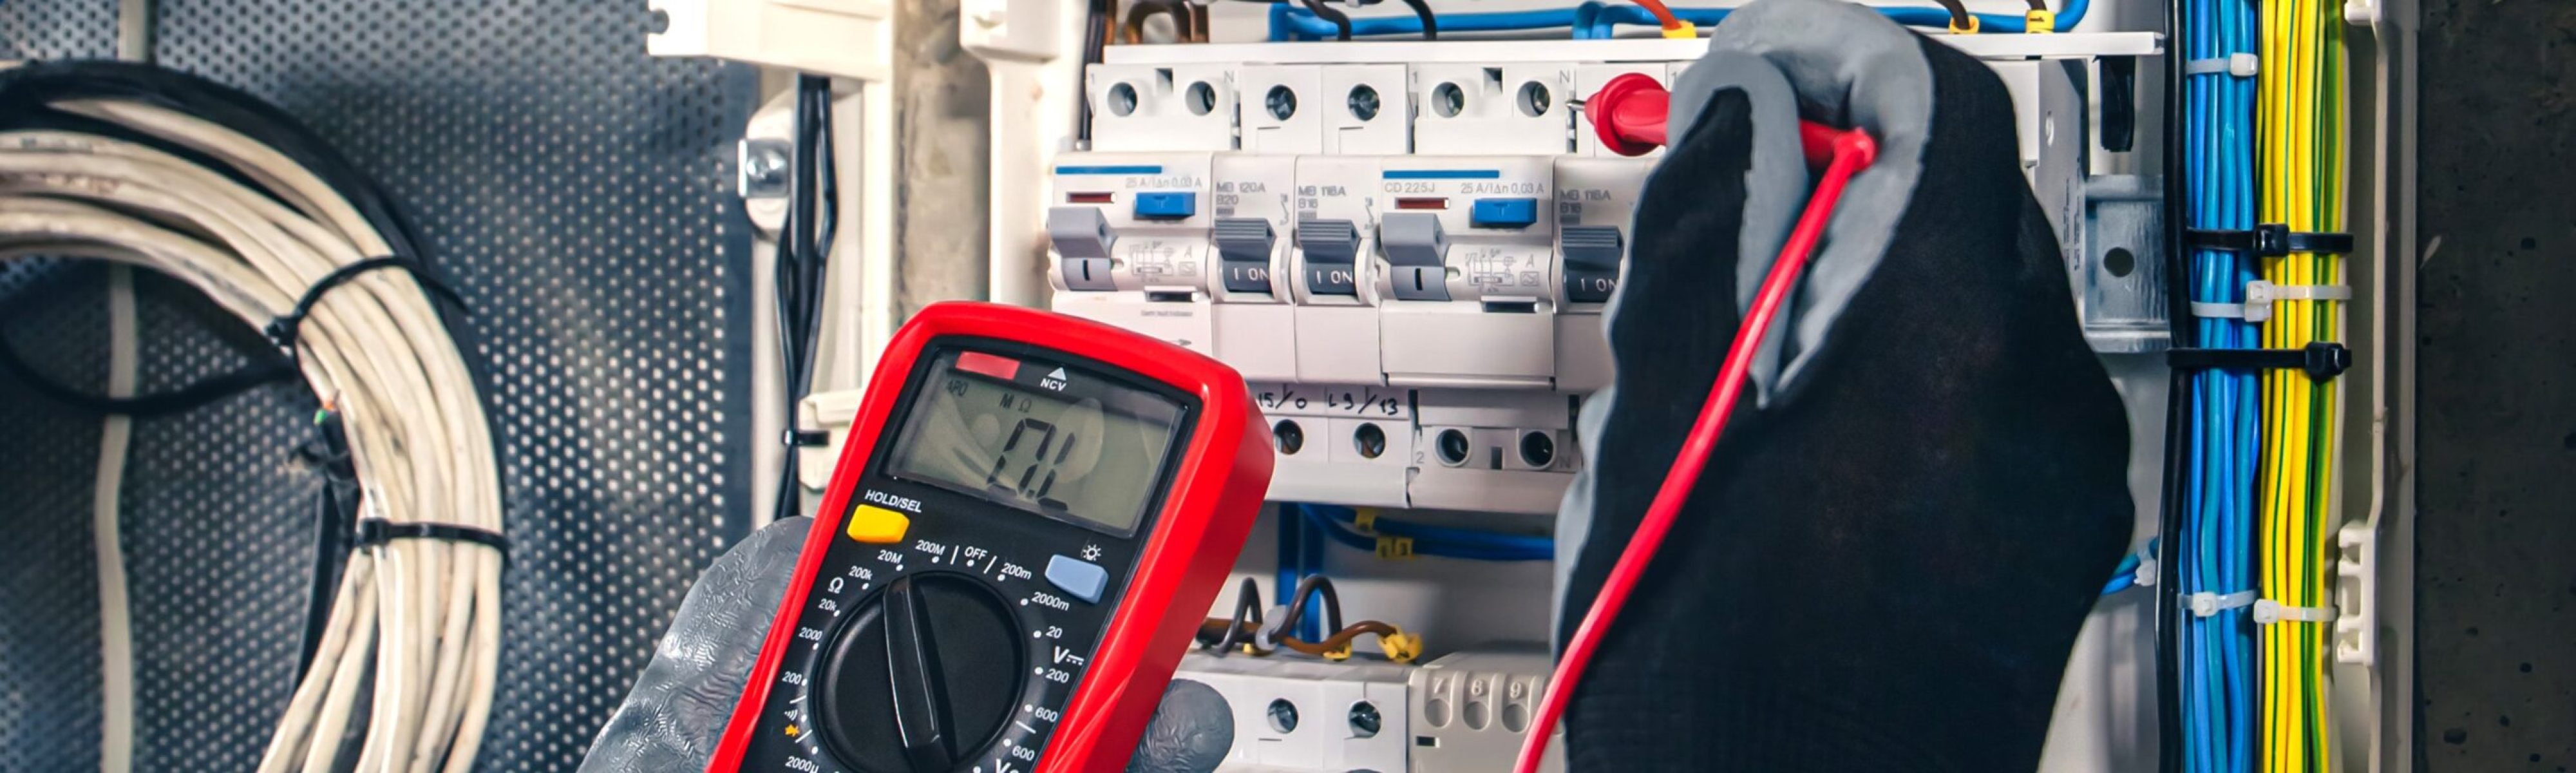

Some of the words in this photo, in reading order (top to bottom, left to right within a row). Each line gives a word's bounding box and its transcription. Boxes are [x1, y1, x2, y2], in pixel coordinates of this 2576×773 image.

[1224, 70, 1235, 83] N
[1559, 70, 1570, 83] N
[1195, 177, 1202, 187] A
[1385, 182, 1403, 193] CD
[1405, 182, 1435, 194] 225J
[1460, 183, 1473, 194] 25
[1536, 183, 1544, 194] A
[1248, 267, 1269, 281] ON
[1331, 271, 1353, 284] ON
[1040, 377, 1067, 392] NCV
[1416, 452, 1425, 464] 2
[865, 489, 922, 513] HOLD/SEL
[915, 539, 945, 556] 200M
[964, 546, 988, 560] OFF
[877, 549, 903, 564] 20M
[848, 566, 873, 580] 200k
[1001, 562, 1032, 580] 200m
[818, 598, 837, 611] 20k
[1032, 591, 1070, 611] 2000m
[799, 627, 823, 641] 2000
[1045, 625, 1063, 639] 20
[782, 671, 802, 685] 200
[1046, 668, 1070, 684] 200
[1510, 681, 1522, 699] 9
[1035, 707, 1058, 723] 600
[1012, 745, 1035, 761] 600
